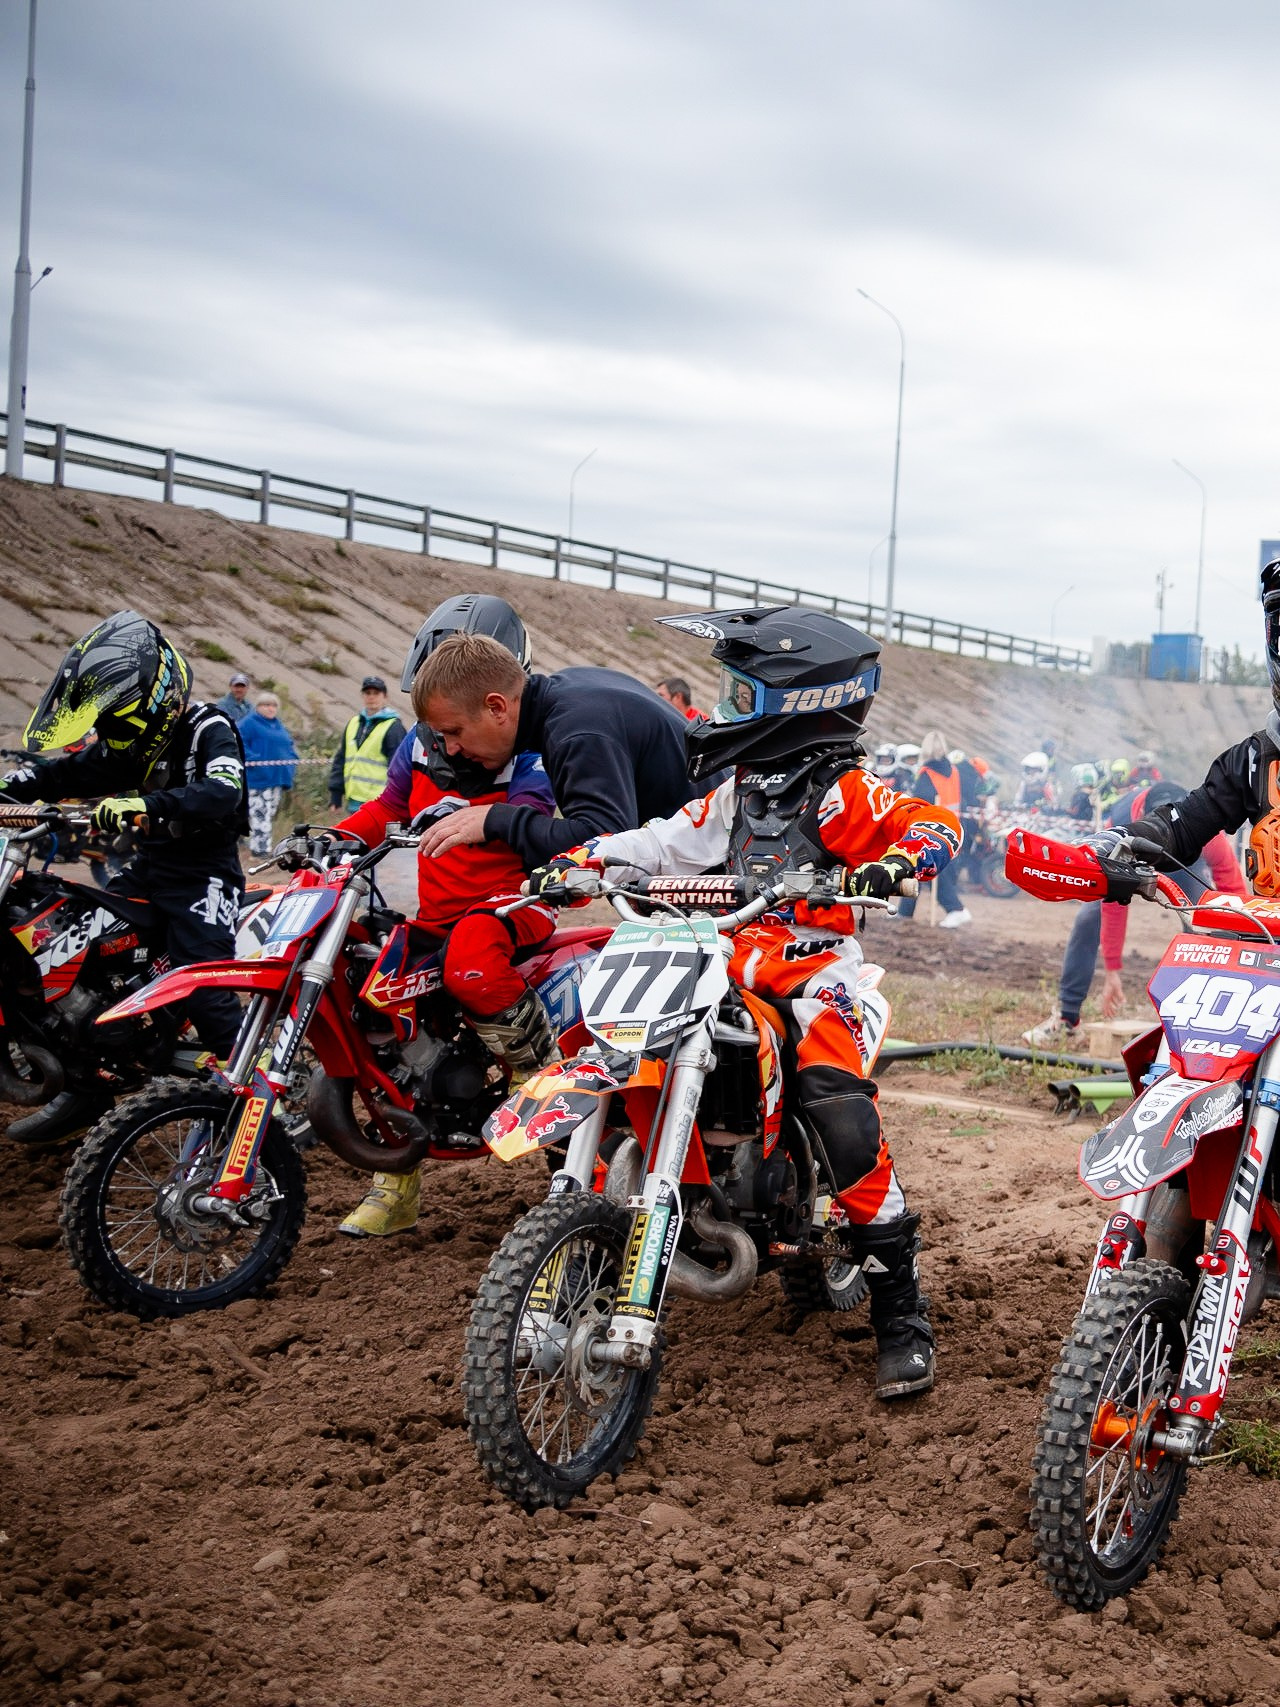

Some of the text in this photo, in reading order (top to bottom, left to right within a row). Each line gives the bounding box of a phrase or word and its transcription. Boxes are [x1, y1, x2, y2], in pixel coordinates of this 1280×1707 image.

[780, 677, 866, 713] 100%
[741, 773, 787, 789] ATLAS
[647, 879, 736, 890] RENTHAL
[1022, 865, 1091, 888] RACETECH
[649, 892, 738, 904] RENTHAL
[1175, 943, 1232, 955] VSEVOLOD
[1173, 951, 1230, 965] TYUKIN
[586, 950, 715, 1018] 777
[614, 1030, 643, 1038] KOPRON
[226, 1099, 265, 1177] PIRELLI
[664, 1214, 679, 1255] ATHENA
[639, 1210, 668, 1276] MOTOREX
[616, 1304, 656, 1318] ACERBIS
